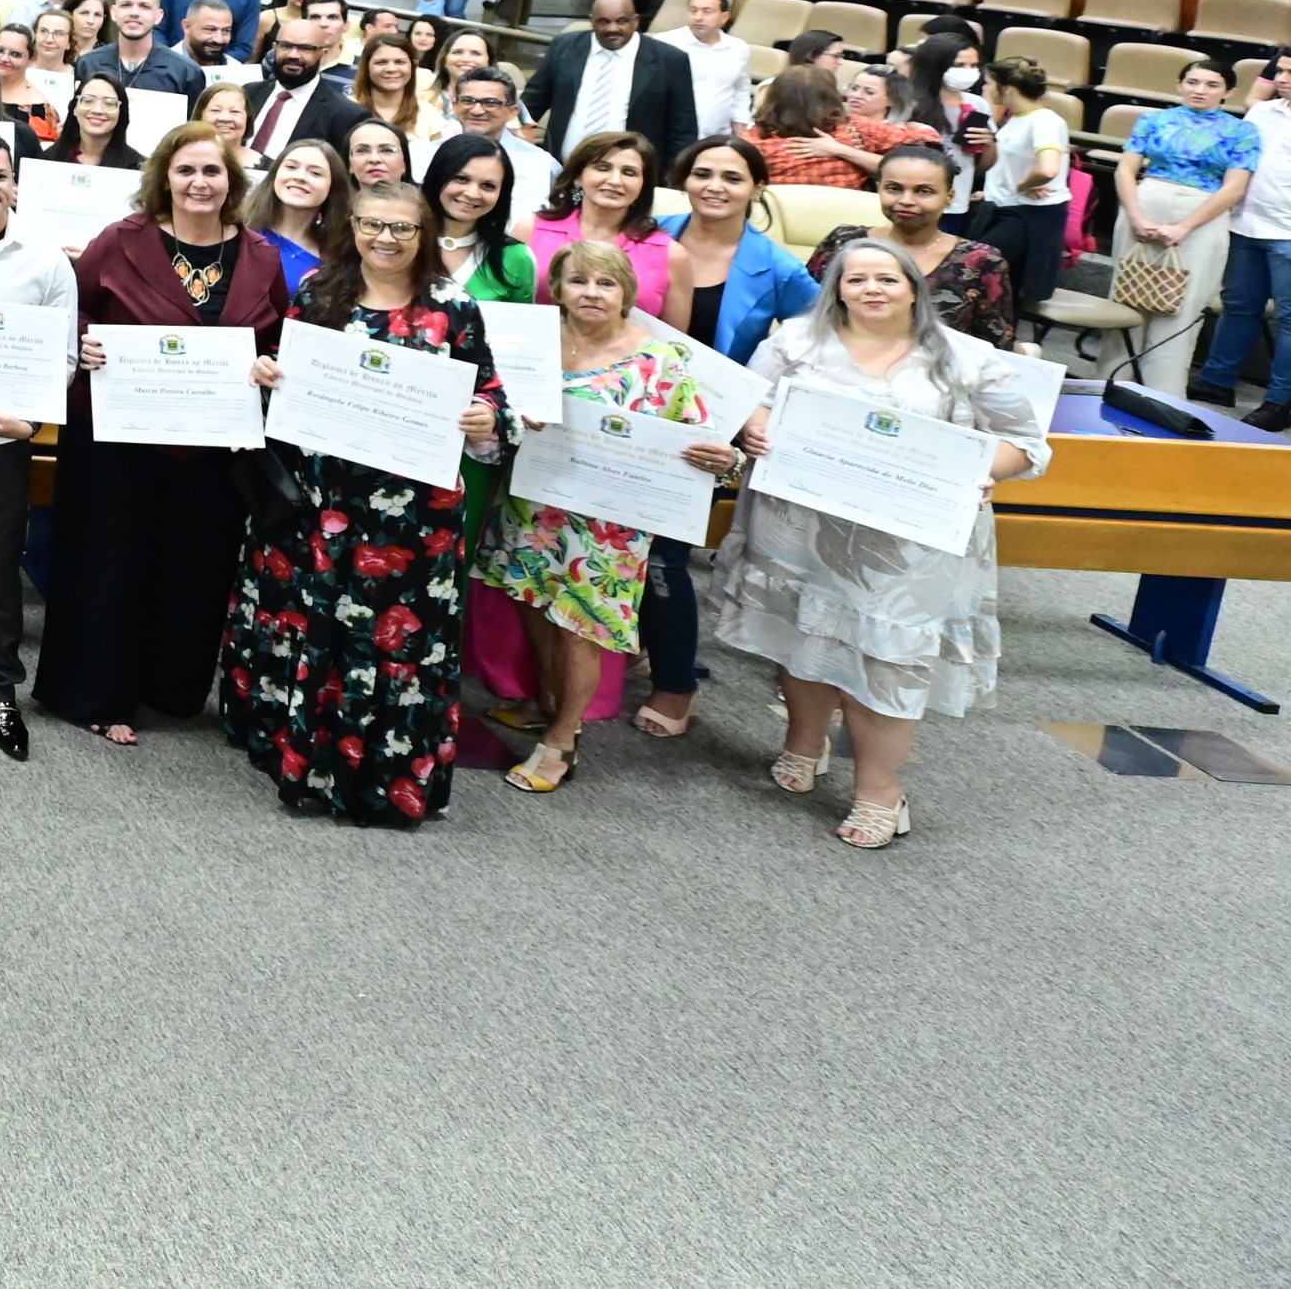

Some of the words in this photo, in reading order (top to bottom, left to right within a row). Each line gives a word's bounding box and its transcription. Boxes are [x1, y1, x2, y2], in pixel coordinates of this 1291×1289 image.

[3, 362, 28, 371] Barbosa
[310, 358, 346, 375] Diploma
[349, 368, 358, 377] de
[362, 372, 390, 386] Honra
[392, 381, 402, 389] ao
[405, 383, 438, 399] Mérito
[372, 407, 400, 421] Ribeiro
[401, 415, 429, 429] Gomes
[837, 456, 880, 476] Aparecida
[881, 469, 892, 478] de
[894, 473, 917, 486] Melo
[918, 480, 939, 493] Dias
